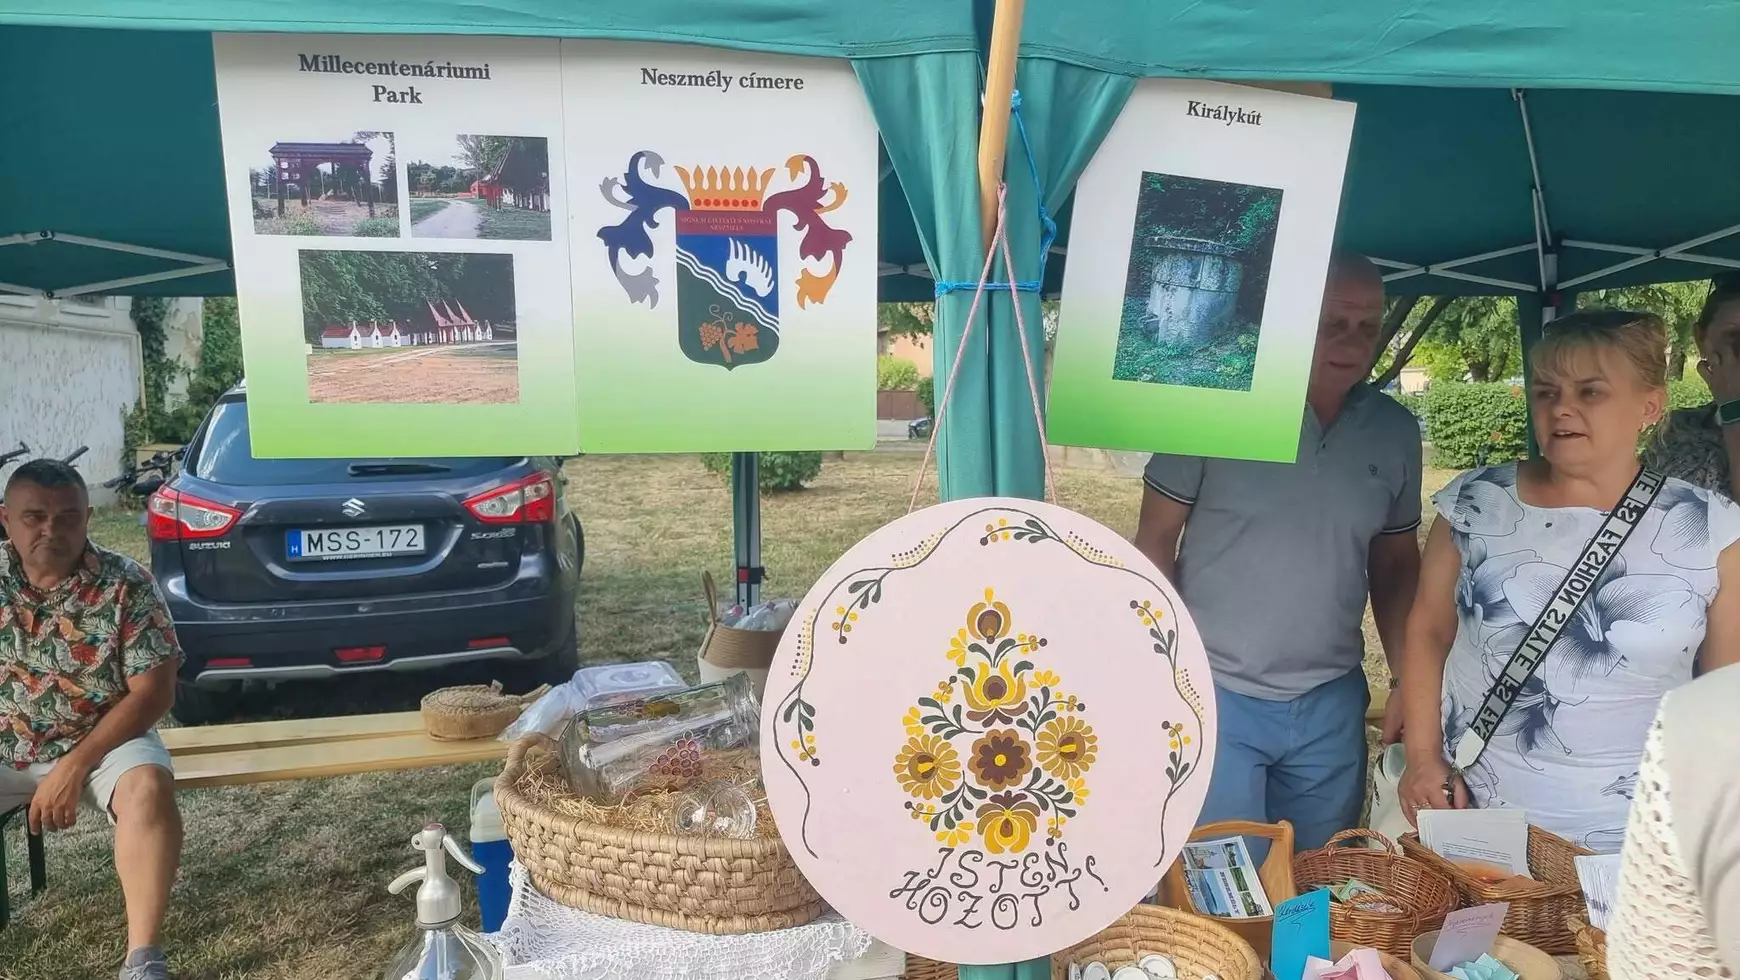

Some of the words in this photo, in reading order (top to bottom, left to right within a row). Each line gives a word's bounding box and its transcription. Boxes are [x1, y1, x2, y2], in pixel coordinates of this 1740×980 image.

[298, 53, 491, 80] Millecentenáriumi
[640, 67, 733, 93] Neszmély
[738, 72, 804, 90] címere
[372, 84, 423, 104] Park
[1186, 100, 1262, 126] Királykút
[189, 541, 231, 550] SUZUKI
[307, 528, 418, 553] MSS-172
